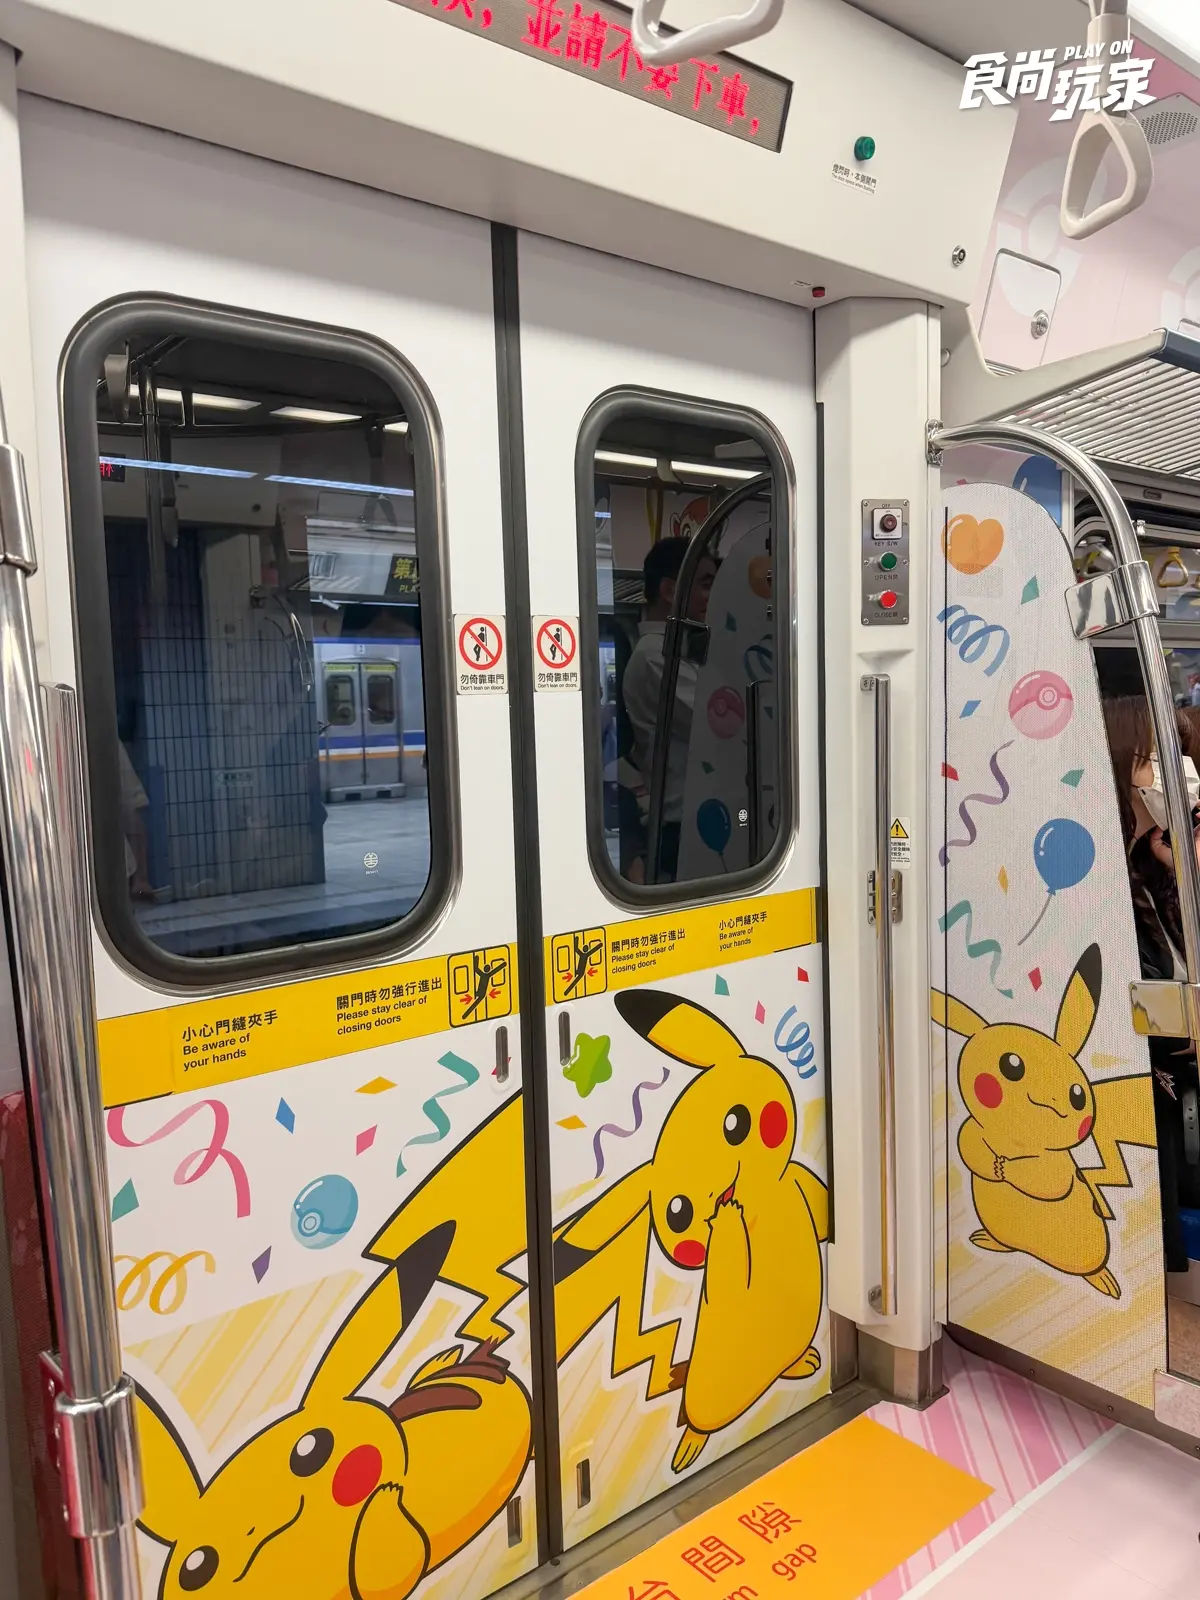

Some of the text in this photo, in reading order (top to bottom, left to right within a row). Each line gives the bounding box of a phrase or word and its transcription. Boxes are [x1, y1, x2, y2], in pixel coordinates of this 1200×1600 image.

[461, 674, 504, 684] 勿倚靠車門
[538, 672, 578, 682] 勿倚靠車門
[719, 911, 767, 931] 小心門縫夾手
[611, 928, 686, 953] 關門時勿強行進出
[719, 926, 754, 941] Be aware of
[611, 943, 675, 963] Please stay clear of
[719, 938, 752, 952] your hands
[611, 959, 657, 974] closing doors
[336, 976, 442, 1010] 關門時勿強行進出
[336, 995, 427, 1022] Please stay clear of
[182, 1009, 278, 1042] 小心門縫夾手
[337, 1015, 402, 1035] closing doors
[183, 1032, 250, 1055] Be aware of
[183, 1048, 247, 1072] your hands
[771, 1543, 817, 1581] gap
